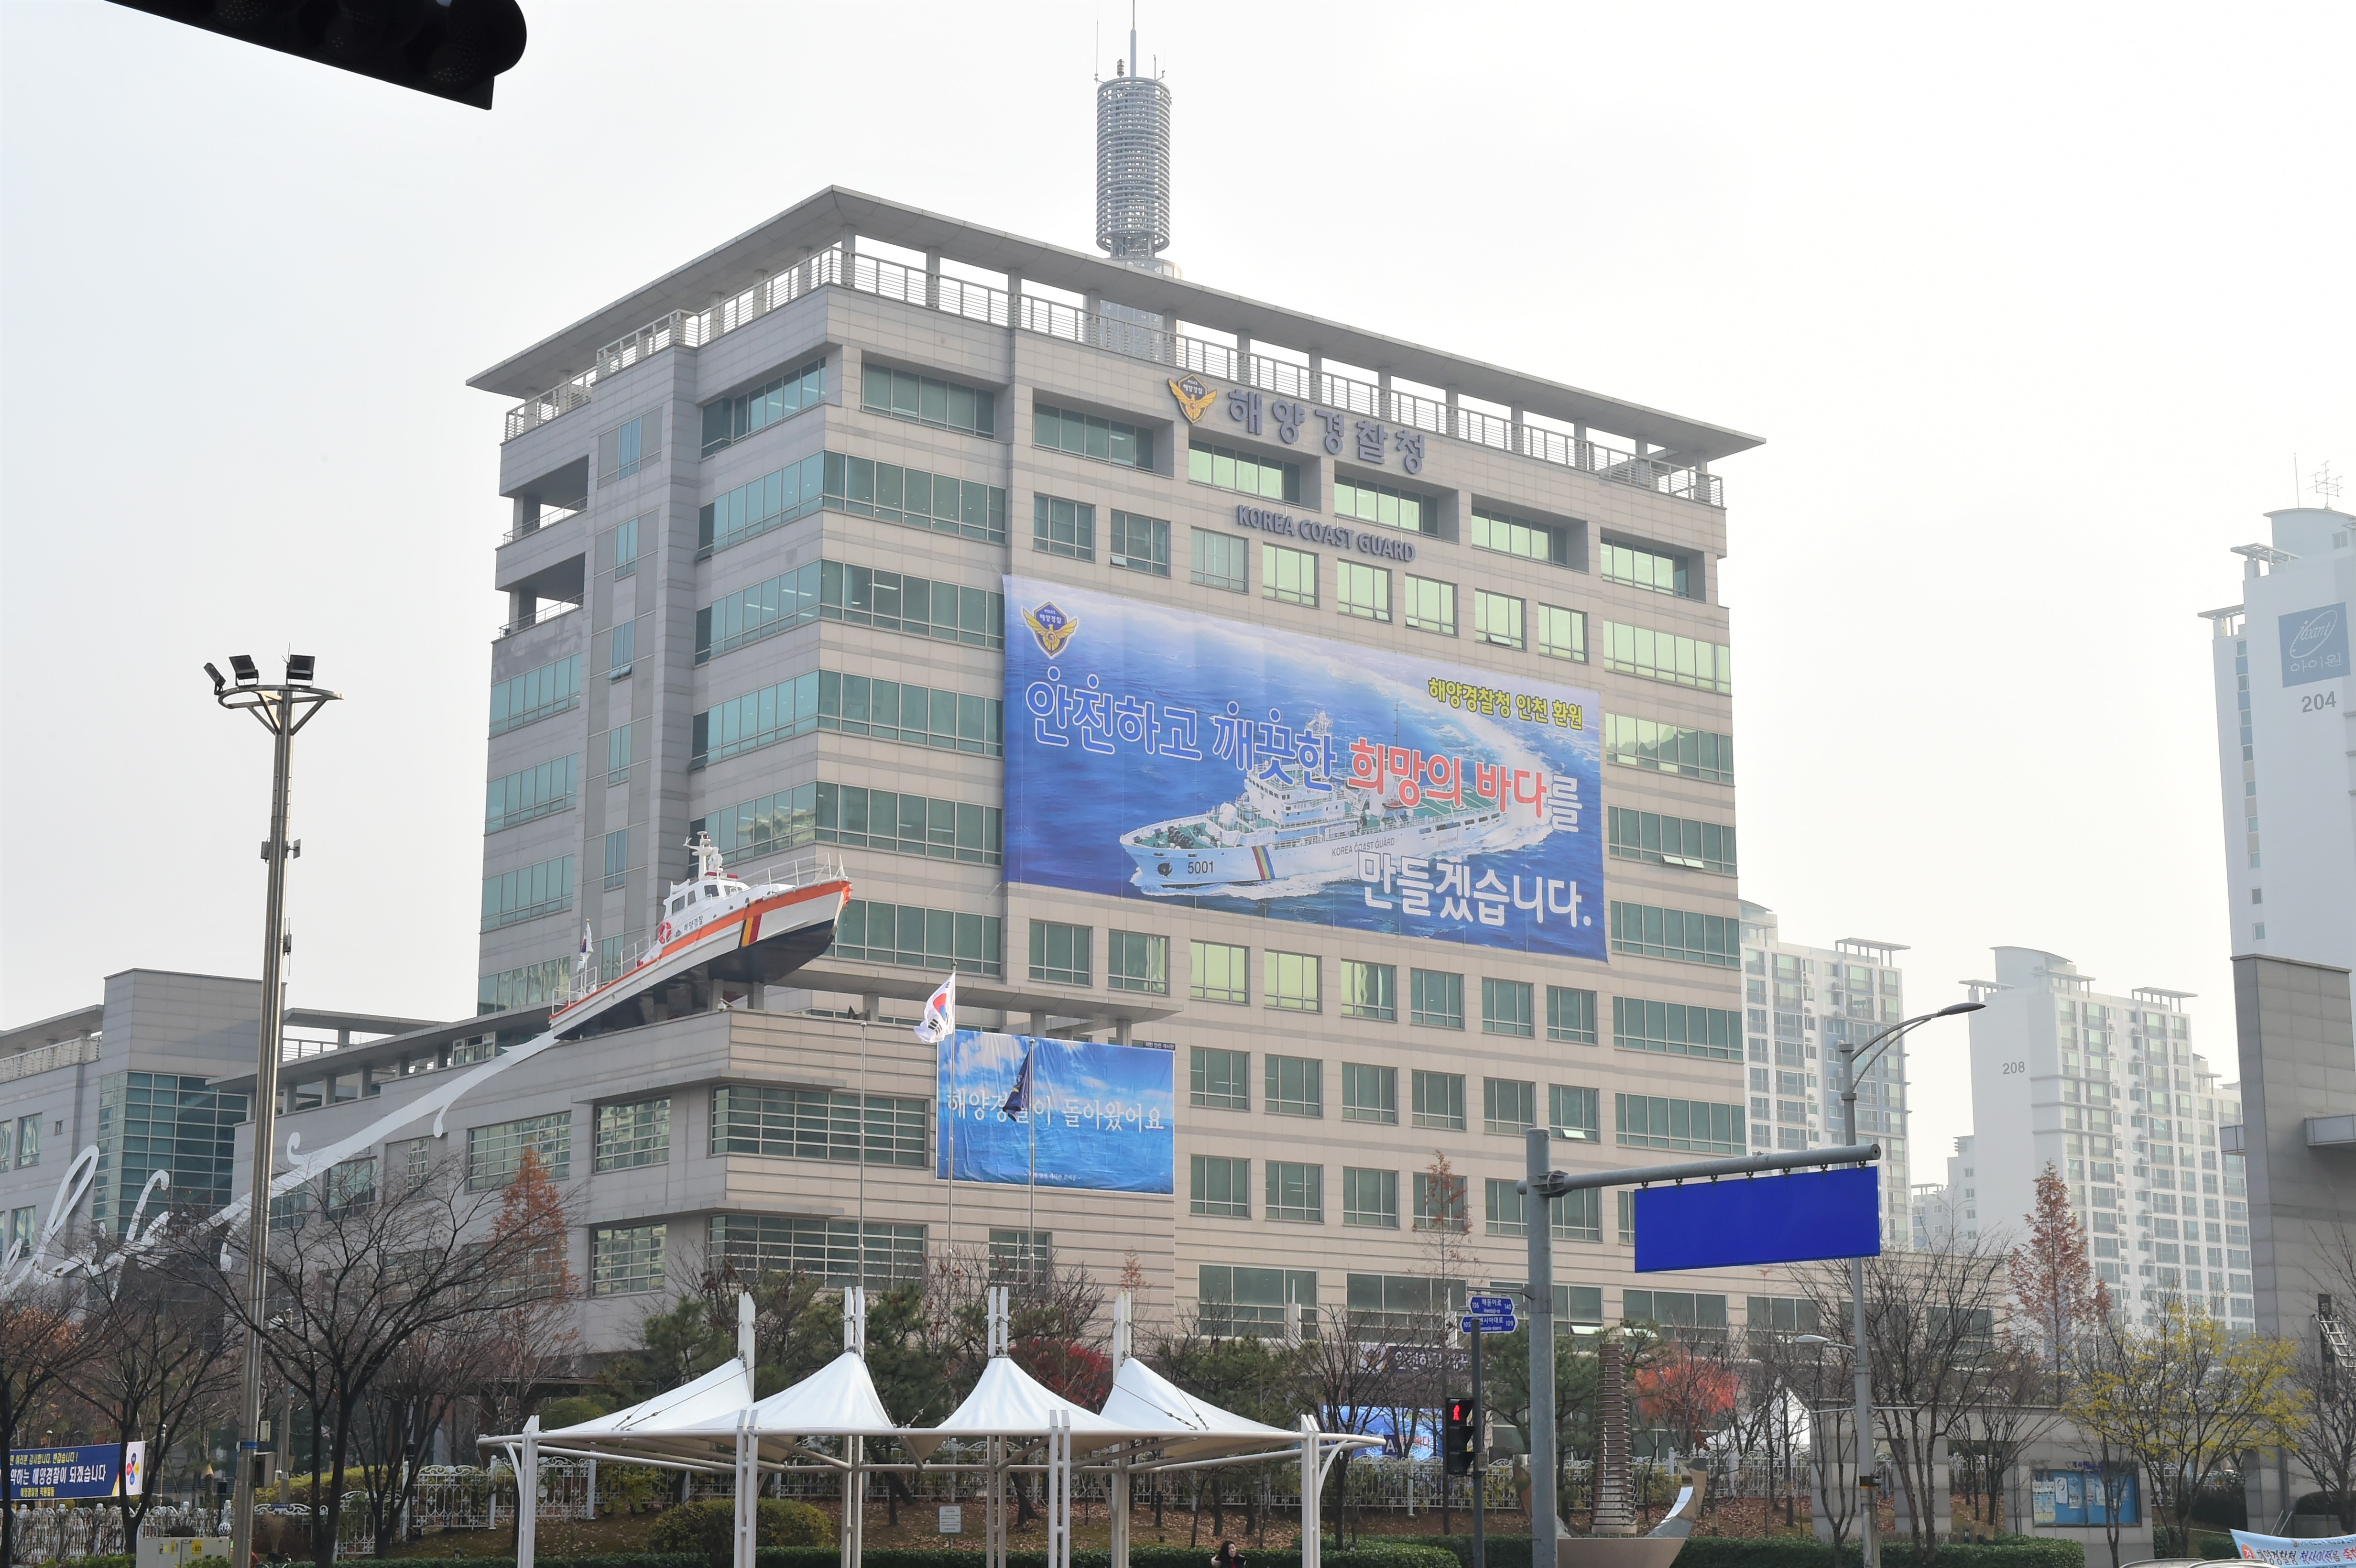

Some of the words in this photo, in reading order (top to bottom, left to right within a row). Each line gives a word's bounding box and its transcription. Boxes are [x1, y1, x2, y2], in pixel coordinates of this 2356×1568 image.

[1183, 384, 1203, 394] 해양경찰
[1228, 388, 1425, 474] 해양경찰청
[1238, 504, 1297, 536] KOREA
[1300, 519, 1355, 548] COAST
[1358, 533, 1416, 562] GUARD
[1039, 614, 1062, 624] 해양경찰
[2291, 653, 2342, 673] 아이원
[1428, 677, 1511, 719] 해양경찰청
[1516, 694, 1549, 724] 인천
[1552, 699, 1583, 731] 환원
[2301, 691, 2337, 713] 204
[1025, 666, 1202, 761] 안전하고
[1212, 700, 1337, 792] 깨끗한
[1347, 737, 1462, 808] 희망의
[1475, 761, 1583, 833] 바다를
[1332, 845, 1353, 857] KOREA
[1354, 841, 1374, 852] COAST
[1375, 838, 1395, 849] GUARD
[1187, 861, 1214, 874] 5001
[1358, 850, 1592, 927] 만들겠습니다.
[684, 915, 703, 932] 해양경찰
[2002, 1061, 2025, 1075] 208
[1061, 1099, 1165, 1133] 돌아왔어요
[1482, 1298, 1502, 1307] 해돋이로
[1480, 1317, 1504, 1325] 시아대로
[32, 1466, 67, 1485] 해양경찰이
[69, 1464, 106, 1483] 되겠습니다
